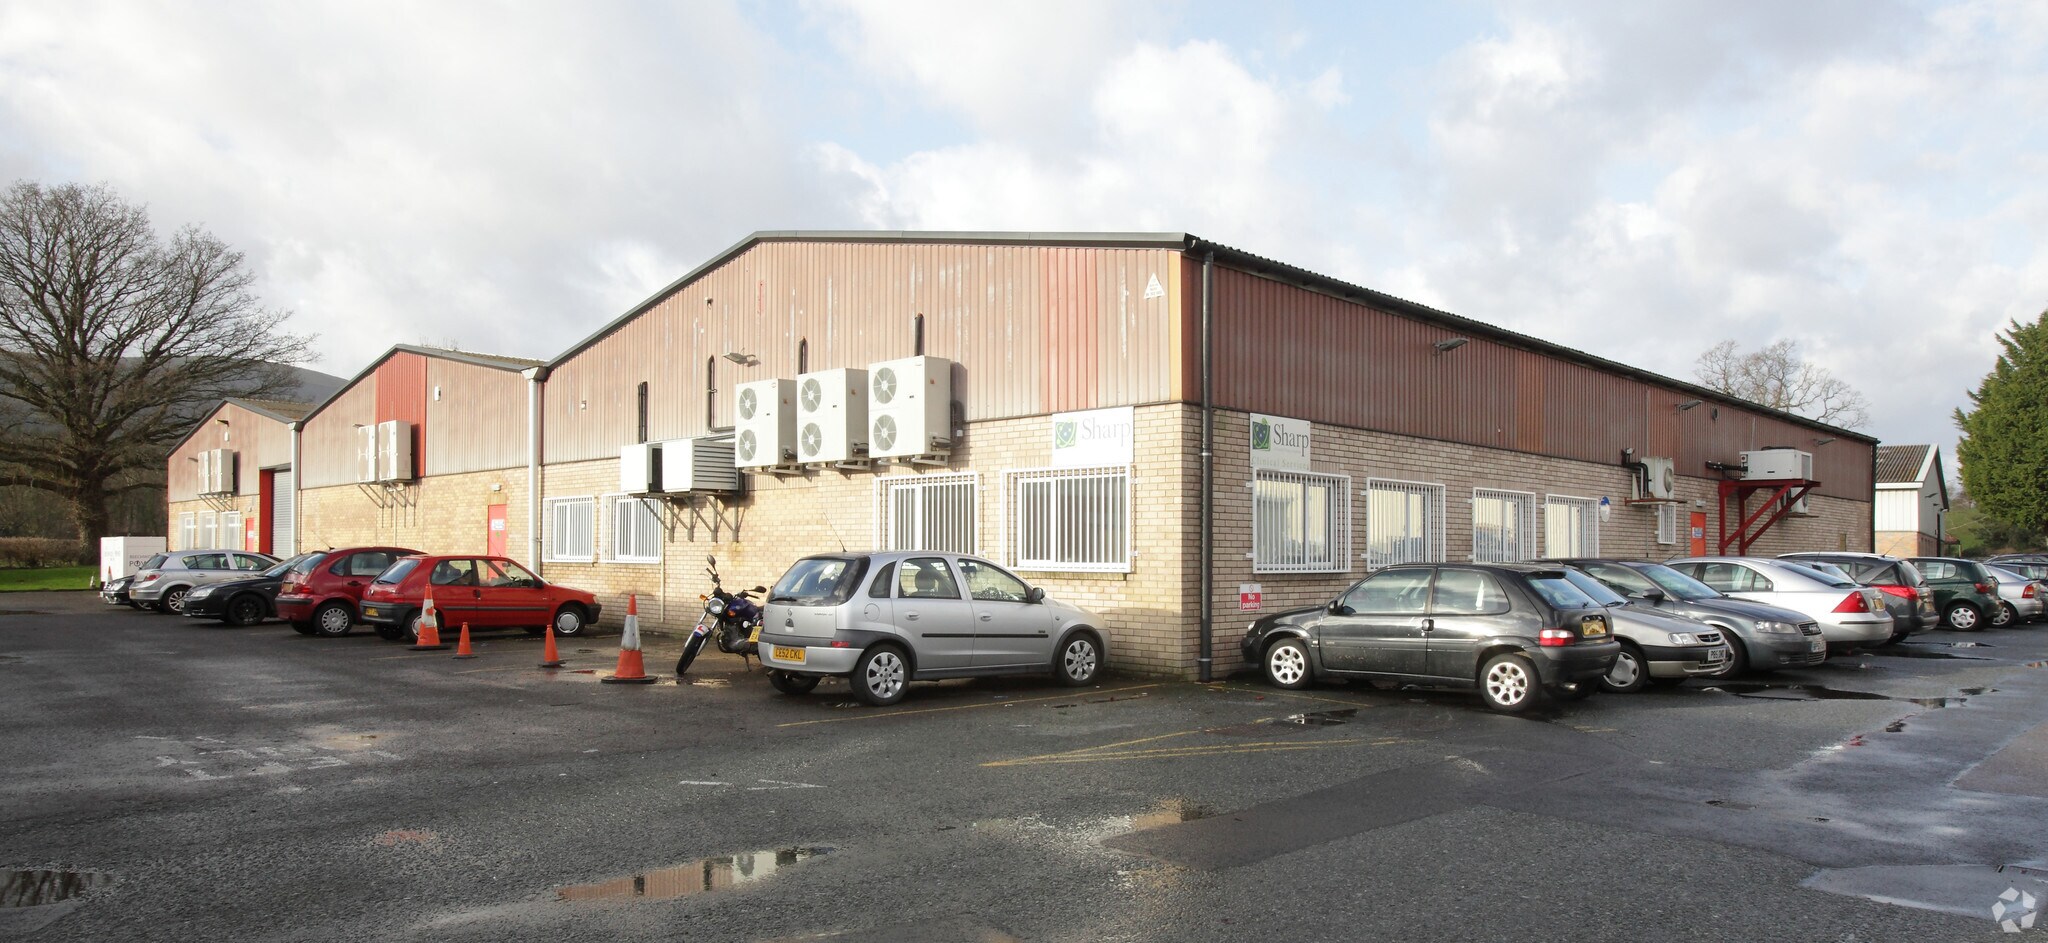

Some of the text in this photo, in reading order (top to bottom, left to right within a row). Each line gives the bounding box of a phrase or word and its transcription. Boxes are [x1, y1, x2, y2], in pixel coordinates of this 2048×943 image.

[1082, 416, 1131, 448] Sharp
[1273, 423, 1309, 457] Sharp
[1251, 455, 1280, 467] Clinical
[1242, 600, 1260, 610] parking
